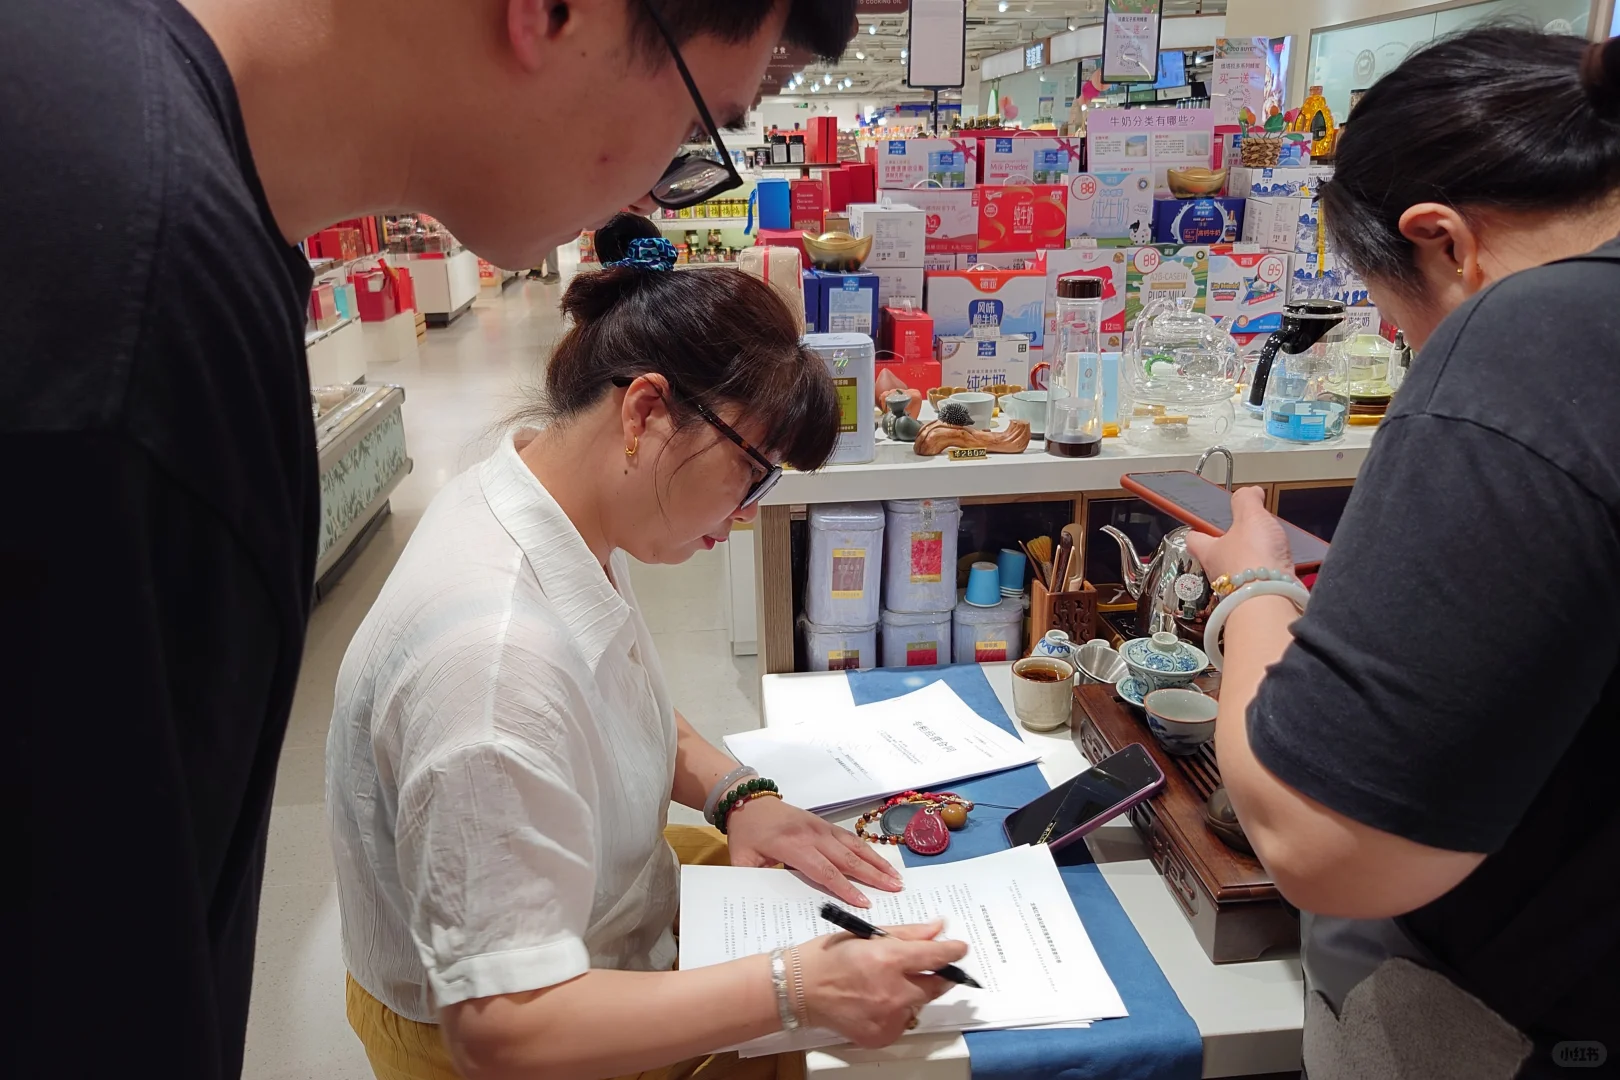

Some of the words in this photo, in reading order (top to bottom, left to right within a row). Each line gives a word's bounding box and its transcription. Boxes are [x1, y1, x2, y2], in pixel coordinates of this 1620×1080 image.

[1219, 73, 1260, 85] 买一送一
[1004, 163, 1029, 171] Powder
[1081, 182, 1095, 194] 88
[1013, 205, 1034, 226] 纯牛奶
[1143, 253, 1157, 267] 88
[1268, 263, 1281, 276] 85
[977, 302, 995, 314] 风味
[1104, 323, 1112, 331] 12
[966, 374, 1007, 392] 纯牛奶
